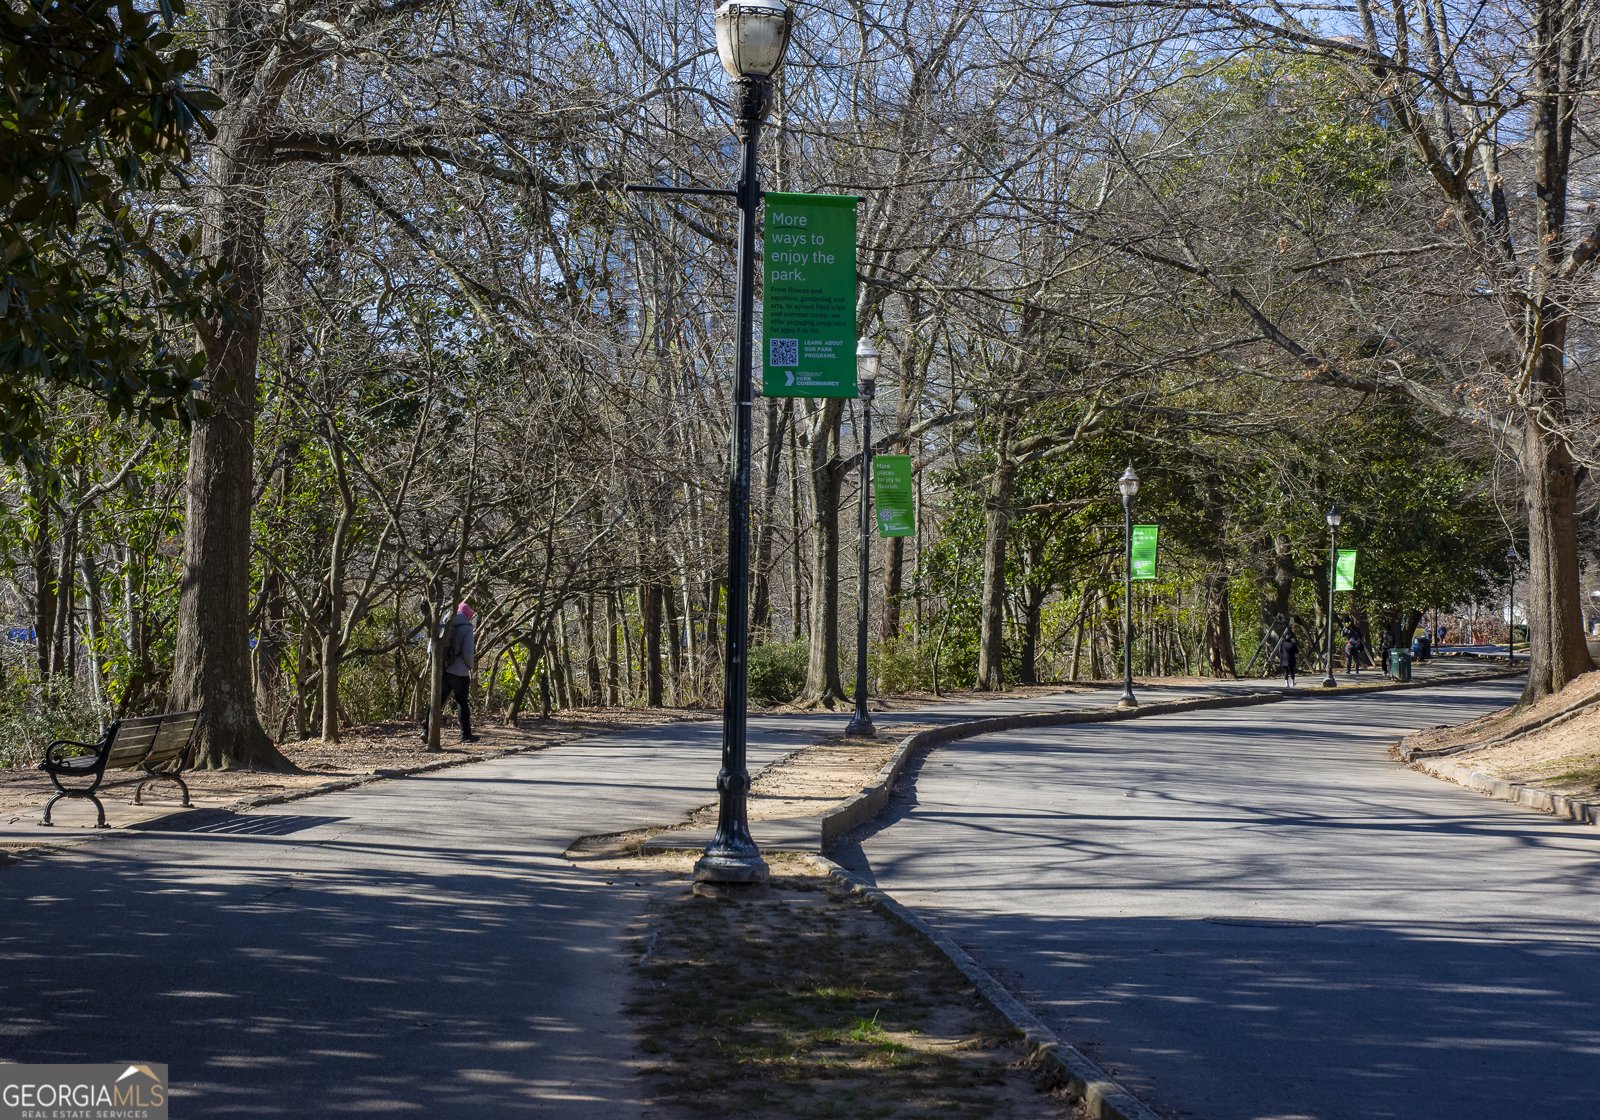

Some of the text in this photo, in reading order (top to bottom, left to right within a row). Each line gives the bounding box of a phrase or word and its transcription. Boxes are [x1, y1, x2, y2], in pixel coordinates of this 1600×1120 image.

[772, 212, 807, 226] More
[771, 234, 825, 247] ways to
[771, 250, 835, 266] enjoy the
[771, 268, 806, 283] park.
